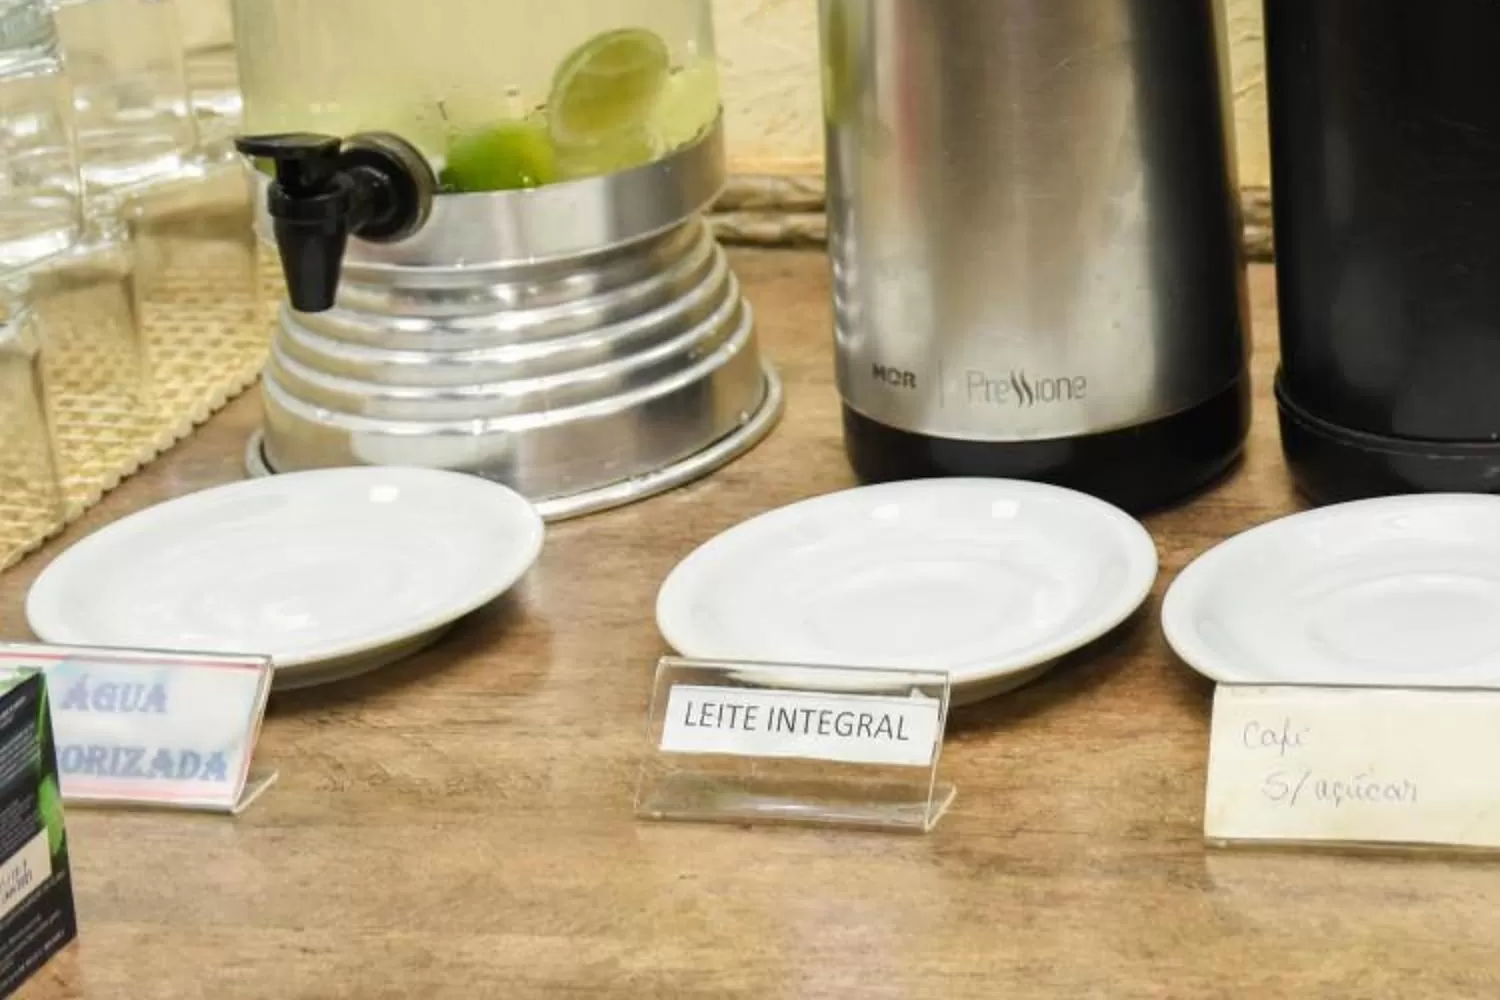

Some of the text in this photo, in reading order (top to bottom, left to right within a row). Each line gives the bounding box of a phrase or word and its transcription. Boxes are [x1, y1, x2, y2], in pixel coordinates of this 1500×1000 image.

[871, 363, 917, 390] MOR
[59, 672, 169, 713] ÁGUA
[683, 701, 910, 741] LEITE INTEGRAL
[56, 743, 227, 782] ORIZADA
